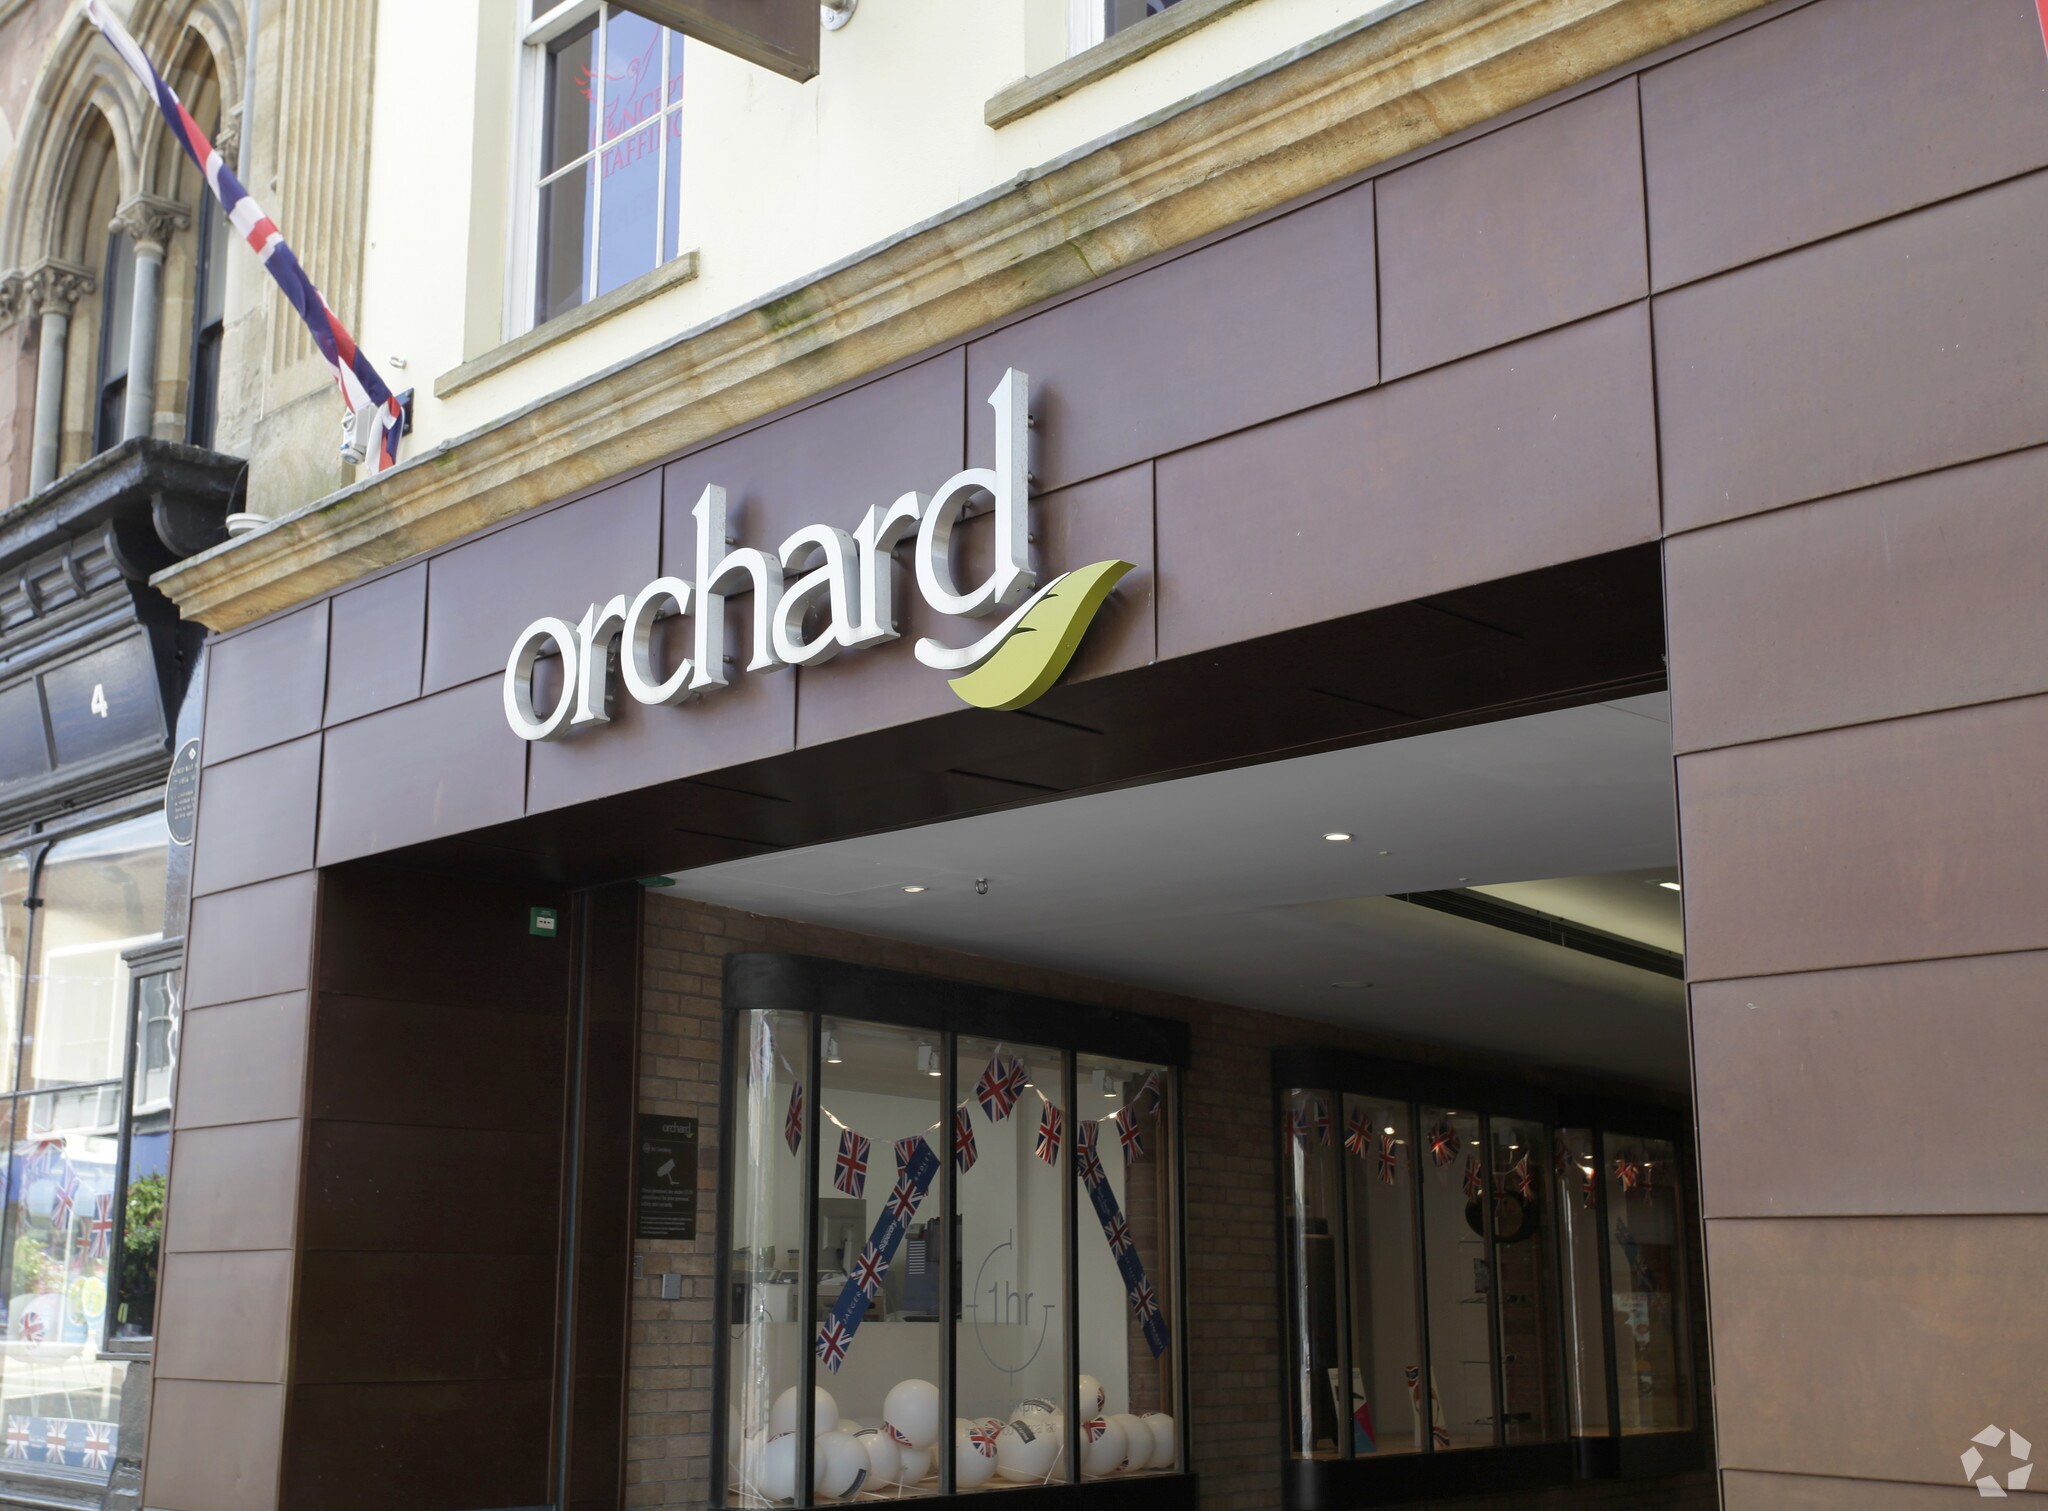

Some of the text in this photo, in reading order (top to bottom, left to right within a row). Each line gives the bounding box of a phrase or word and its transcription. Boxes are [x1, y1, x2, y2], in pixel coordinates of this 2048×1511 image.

[592, 73, 684, 147] NCEPT
[503, 367, 1036, 742] orchard
[91, 684, 108, 718] 4
[662, 1121, 691, 1134] orchard
[842, 1291, 862, 1324] JAEGER
[988, 1281, 1033, 1326] 1hr
